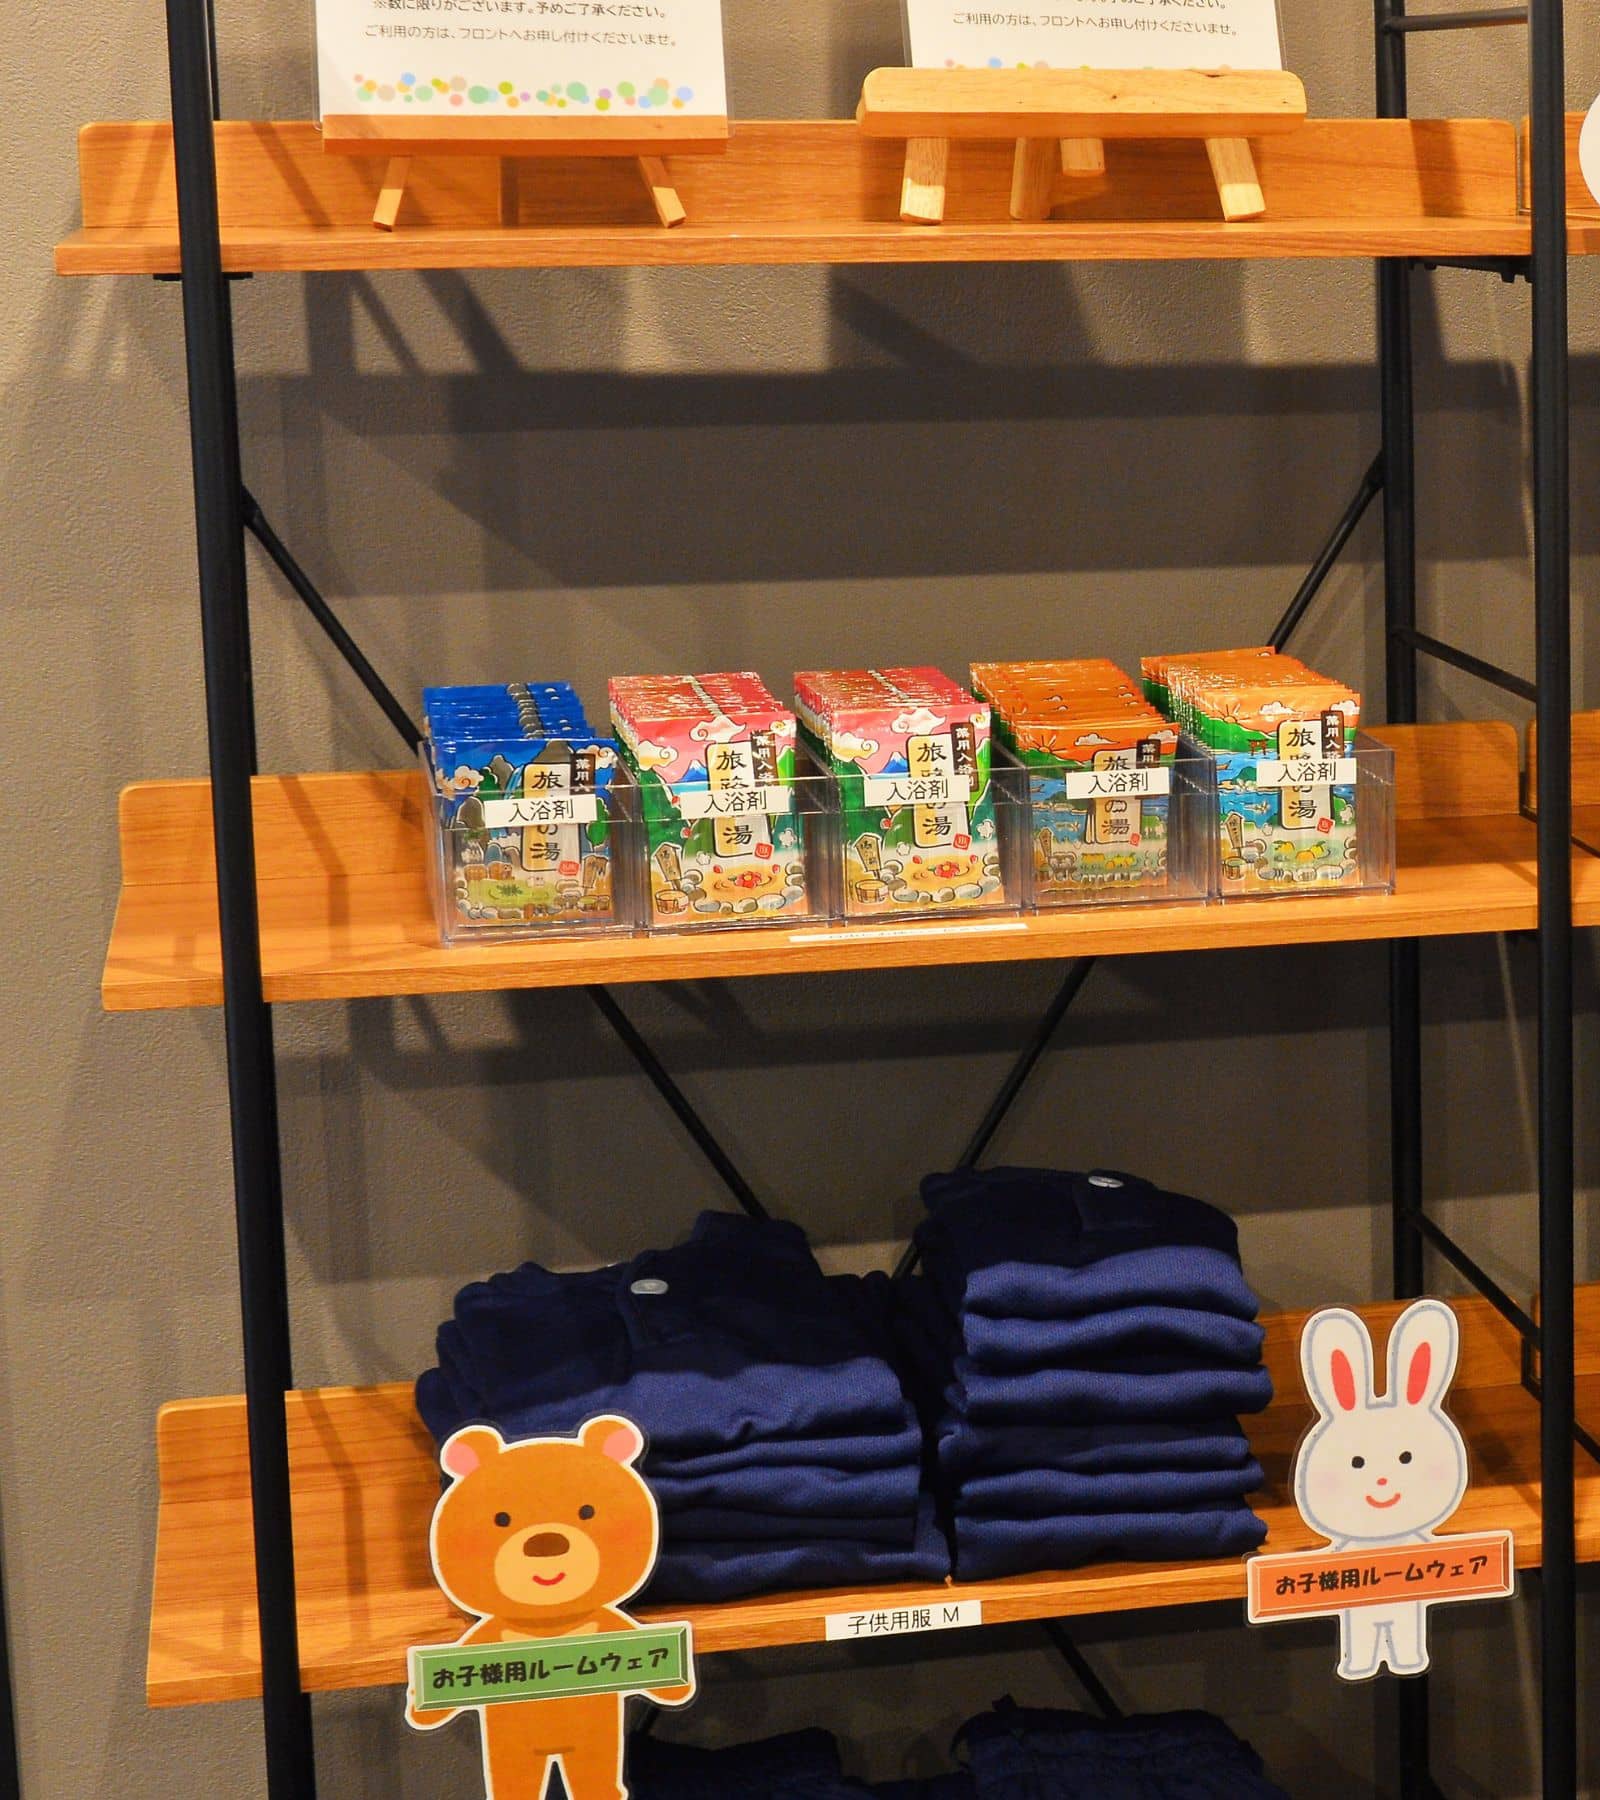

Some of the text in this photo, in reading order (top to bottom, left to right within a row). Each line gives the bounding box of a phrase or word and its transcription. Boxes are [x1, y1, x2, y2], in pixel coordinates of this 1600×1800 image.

[1087, 772, 1149, 794] 入浴剤
[1277, 761, 1336, 783] 入浴剤
[703, 790, 767, 814] 入浴剤
[886, 779, 949, 802] 入浴剤
[508, 799, 574, 823] 入浴剤
[1275, 1555, 1488, 1596] お子様用ルームウェア
[847, 1605, 960, 1635] 子供用服 M
[432, 1647, 669, 1689] お子様用ルームウェア
